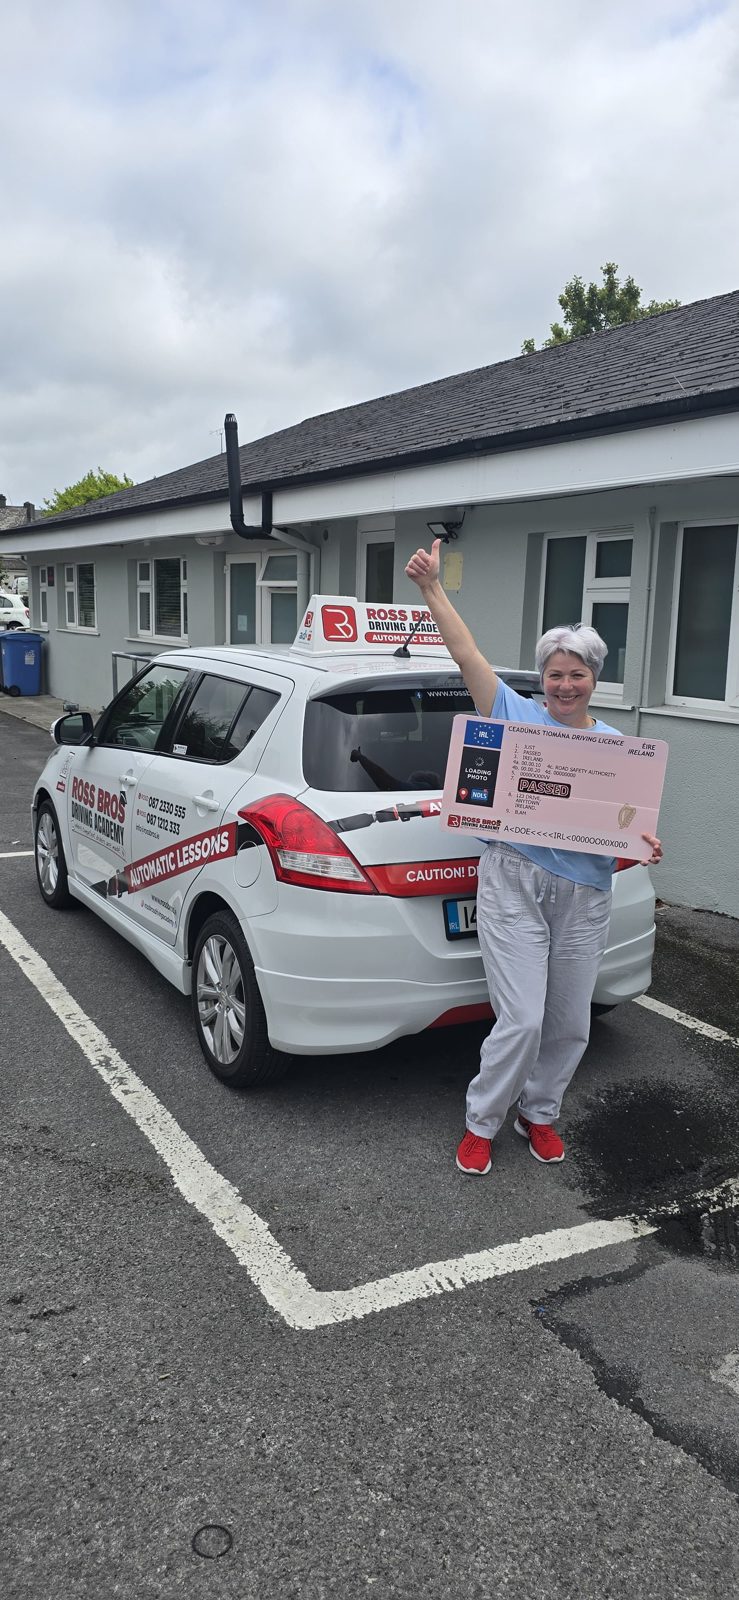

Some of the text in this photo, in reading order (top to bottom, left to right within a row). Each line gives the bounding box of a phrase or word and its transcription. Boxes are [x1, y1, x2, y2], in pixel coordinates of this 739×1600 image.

[366, 608, 434, 622] ROSS BR
[369, 621, 406, 631] DRIVING
[508, 725, 625, 746] CEADÚNAS TIOMÁNA DRIVING LICENCE
[522, 749, 542, 757] PASSED
[627, 748, 655, 757] IRELAND
[641, 742, 656, 751] ÉIRE
[522, 755, 543, 763] IRELAND
[465, 767, 492, 776] LOADING
[570, 766, 588, 774] SAFETY
[589, 769, 616, 778] AUTHORITY
[520, 780, 569, 796] PASSED
[72, 776, 125, 824] ROSS BROS
[148, 796, 159, 809] 087
[159, 800, 174, 815] 2330
[174, 804, 186, 819] 555
[72, 801, 93, 828] DRIVING
[94, 813, 125, 846] ACADEMY
[146, 812, 157, 826] 087
[157, 816, 169, 831] 1212
[169, 821, 180, 836] 333
[462, 816, 501, 827] ROSS BROS
[130, 831, 229, 888] AUTOMATIC LESSONS
[406, 867, 465, 882] CAUTION!
[449, 922, 460, 930] IRL
